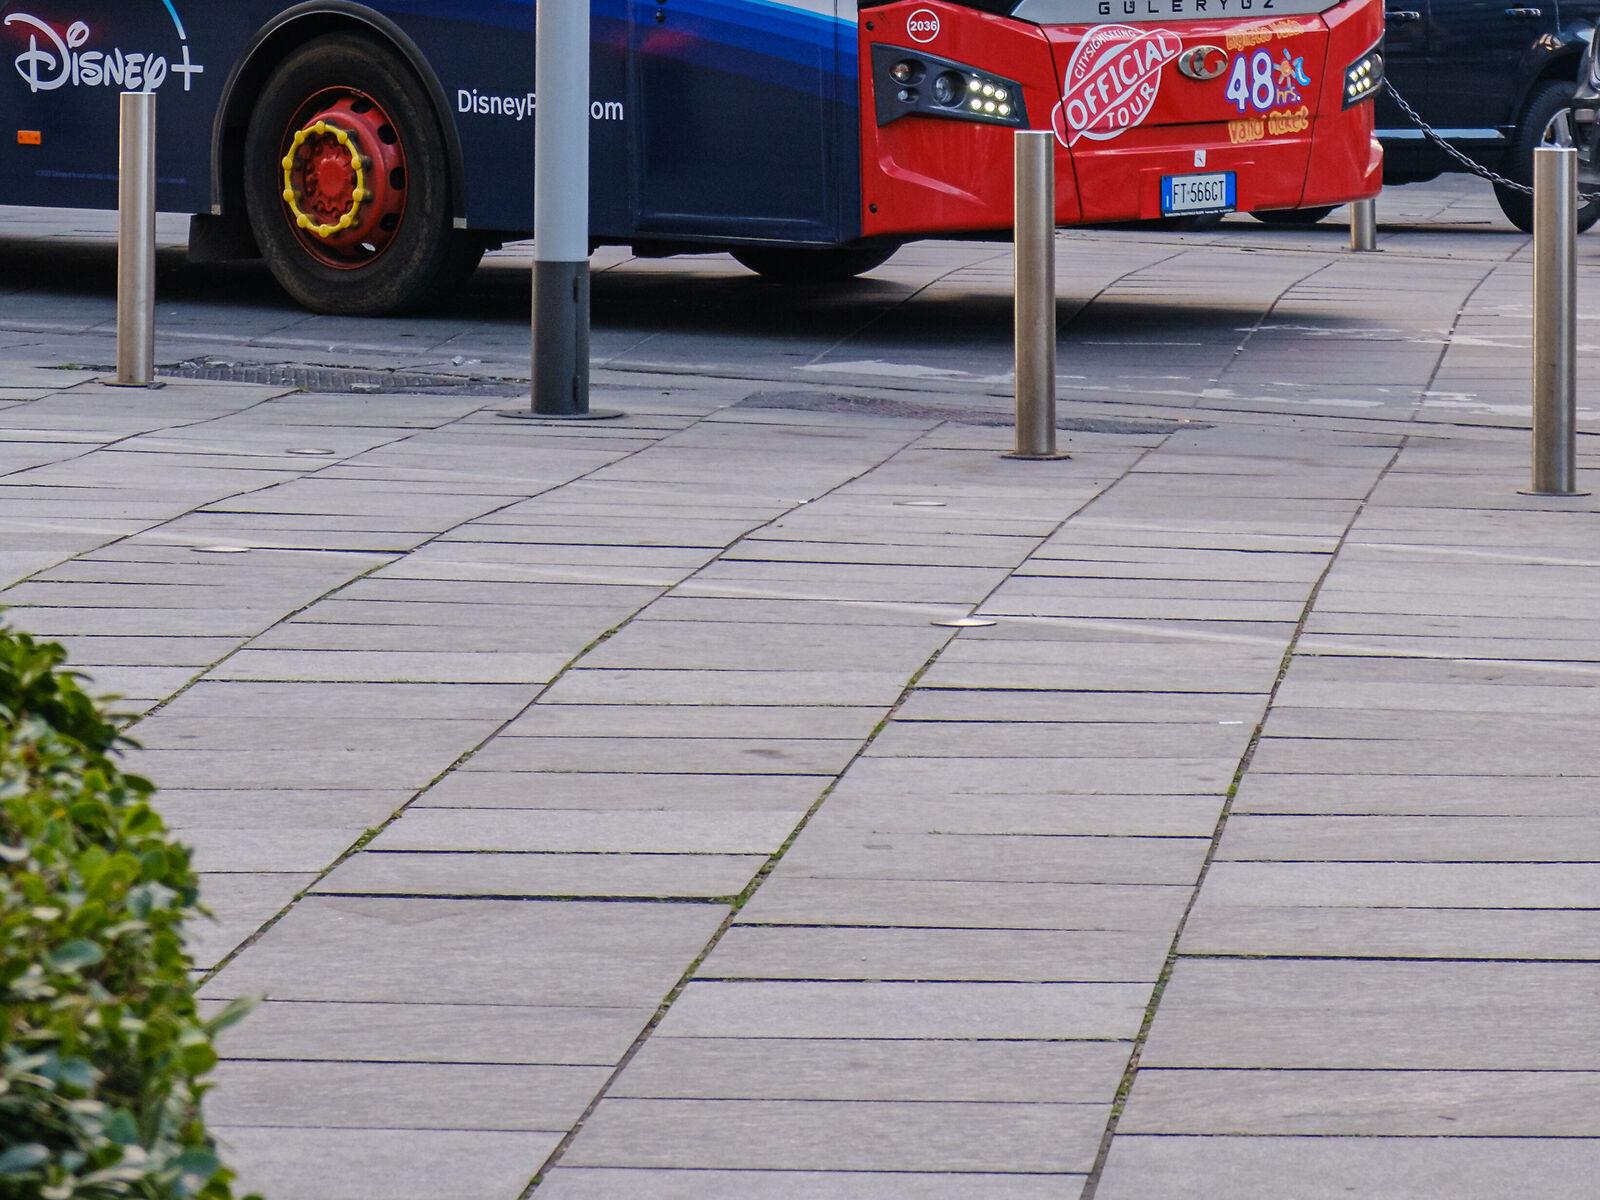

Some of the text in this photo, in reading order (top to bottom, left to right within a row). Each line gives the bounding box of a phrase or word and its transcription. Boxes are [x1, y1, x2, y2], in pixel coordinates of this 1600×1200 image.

[4, 12, 204, 93] Disney+
[910, 20, 937, 31] 2036
[1066, 34, 1175, 131] OFFICIAL
[1107, 82, 1155, 128] TOUR
[1226, 49, 1275, 112] 48
[1173, 183, 1187, 205] FT
